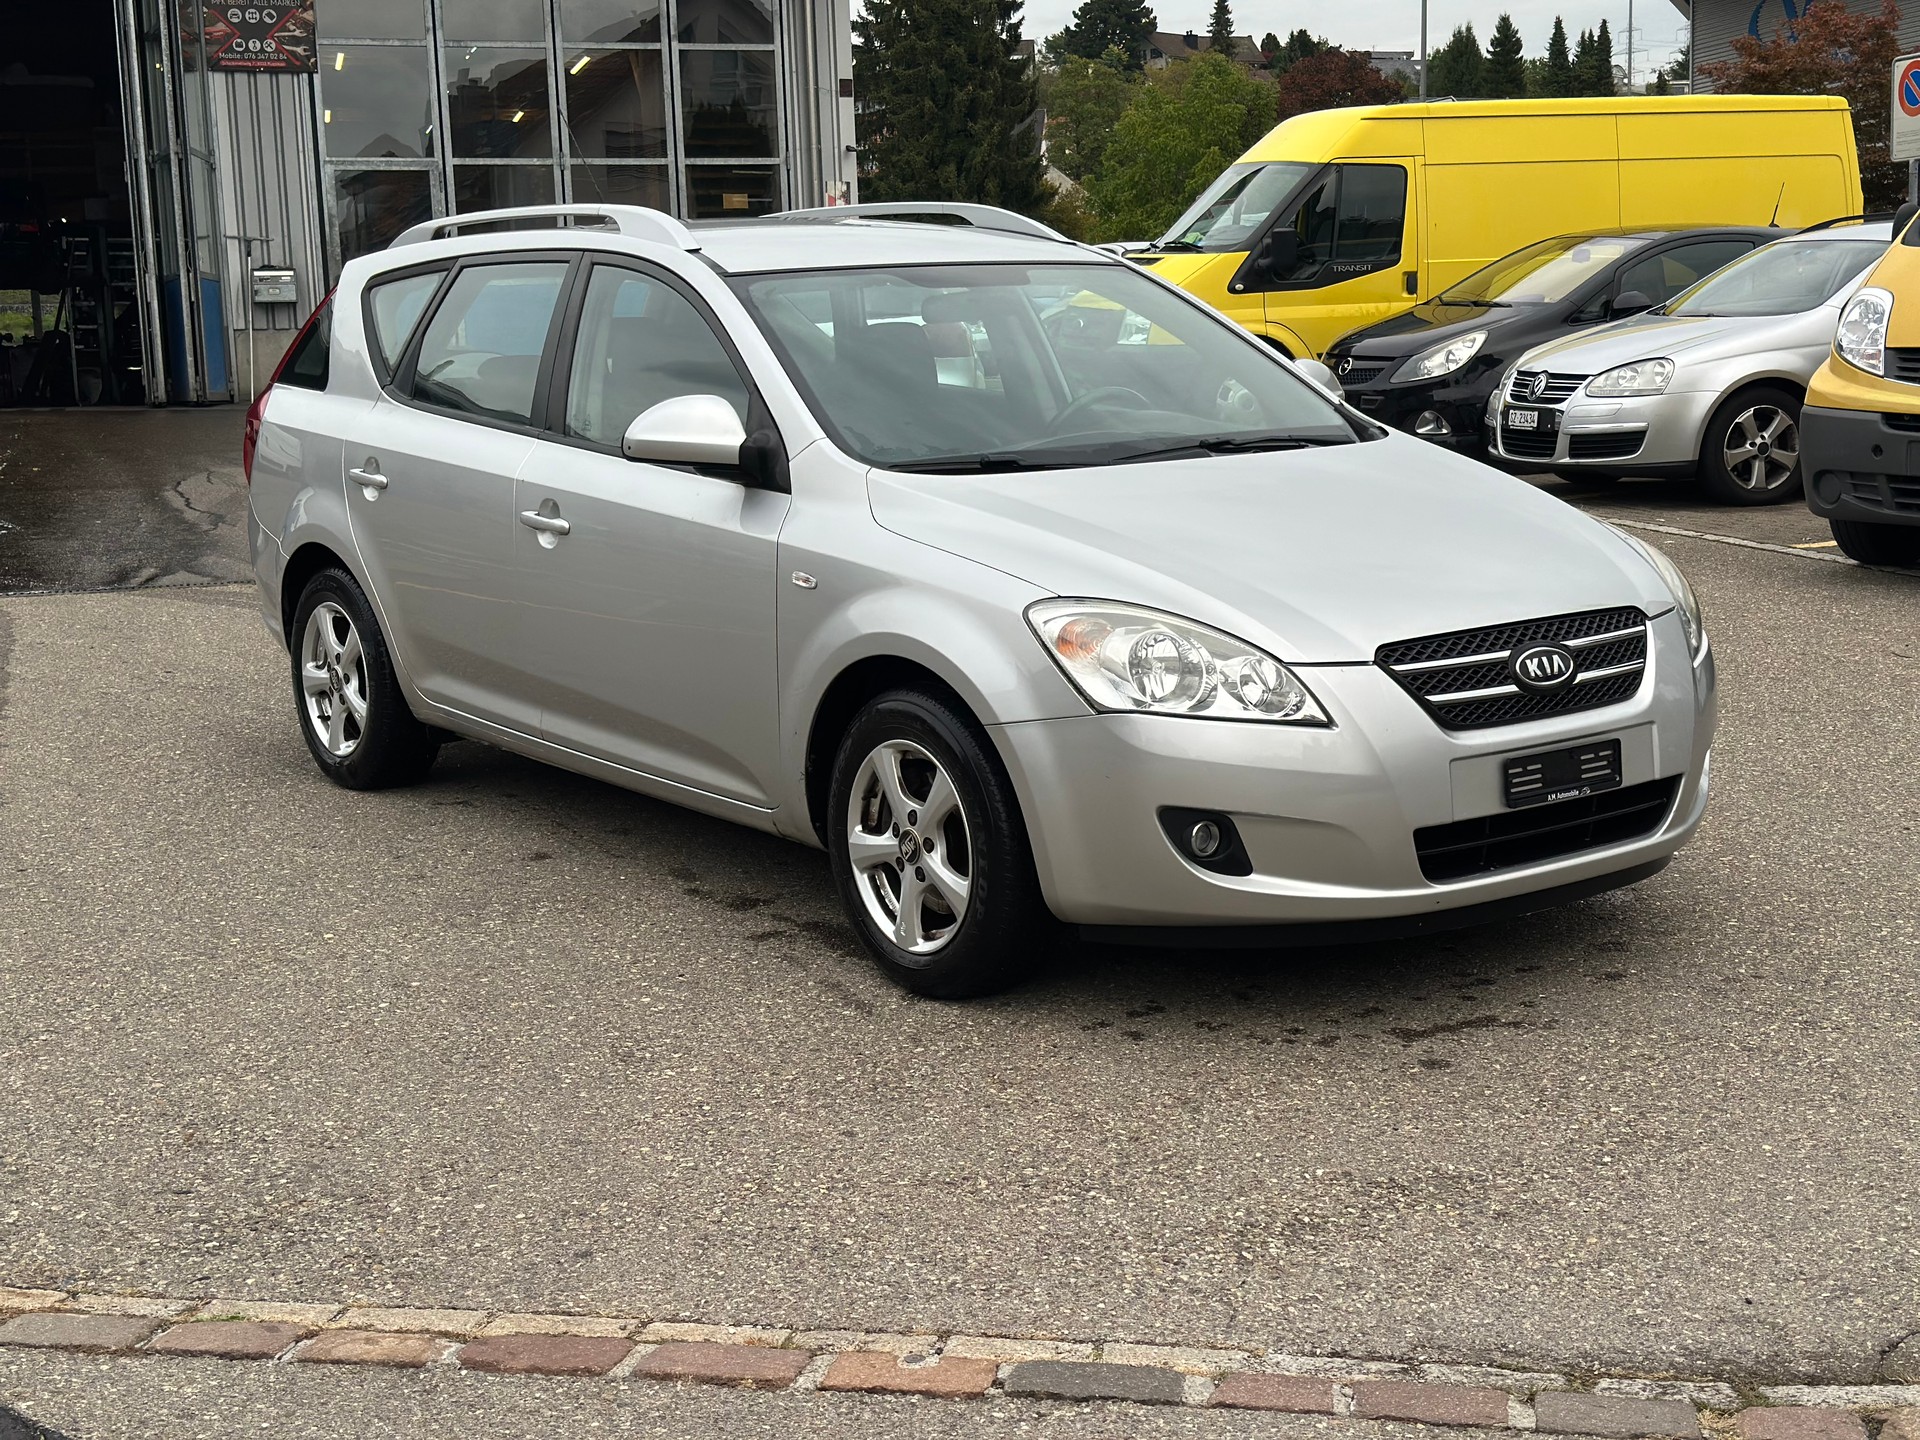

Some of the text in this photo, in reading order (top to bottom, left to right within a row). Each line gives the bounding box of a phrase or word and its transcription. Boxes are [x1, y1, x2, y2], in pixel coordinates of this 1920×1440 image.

[1333, 264, 1372, 272] TRANSIT
[1525, 654, 1567, 679] KIA
[1557, 789, 1579, 800] Automobile
